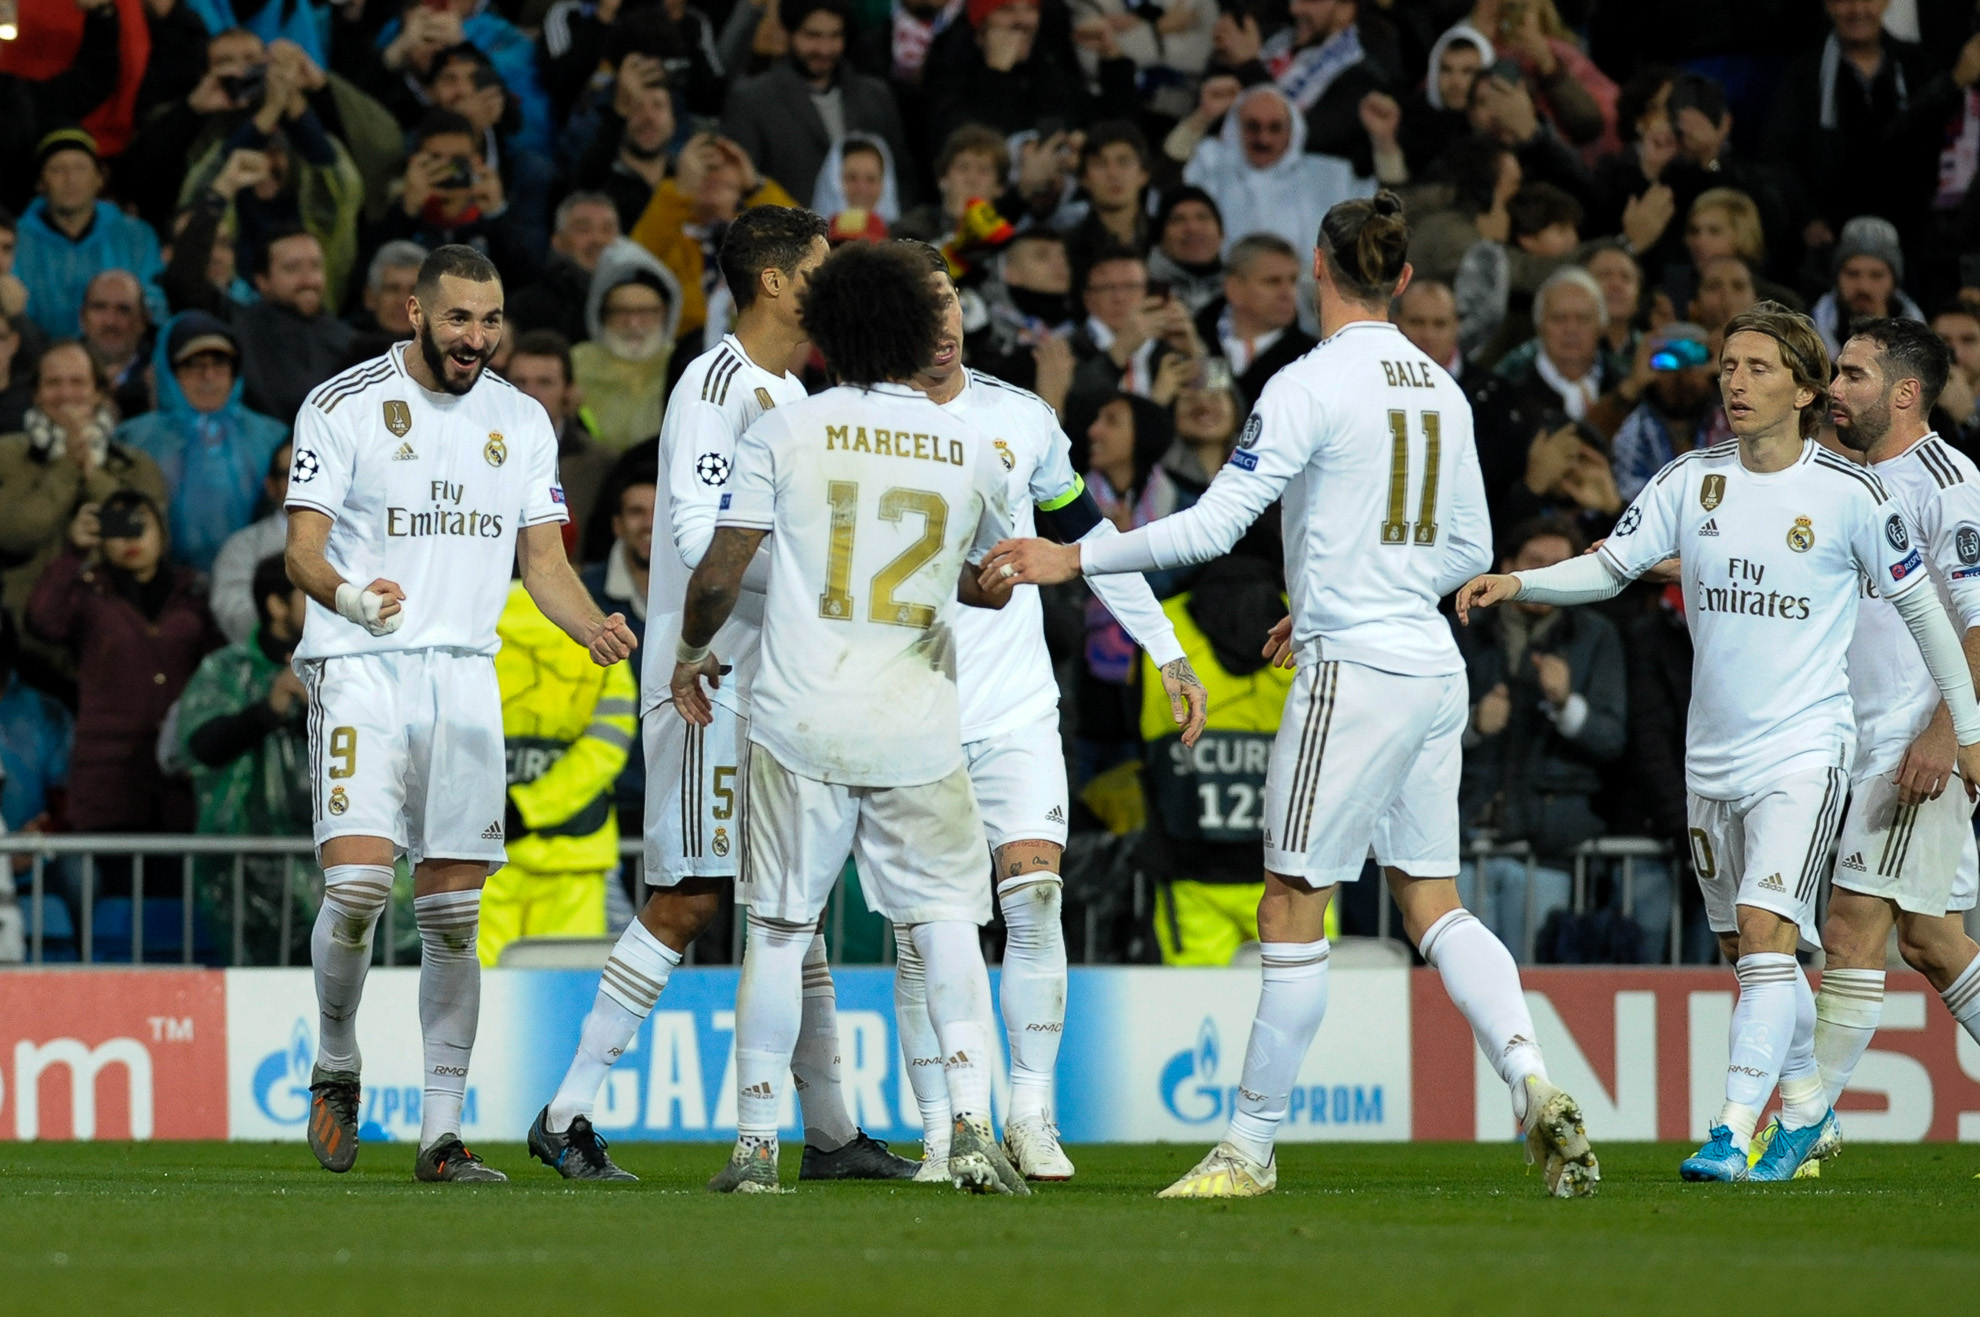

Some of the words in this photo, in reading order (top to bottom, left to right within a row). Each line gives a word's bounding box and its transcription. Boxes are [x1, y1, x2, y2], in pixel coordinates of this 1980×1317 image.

[1380, 360, 1436, 389] BALE
[825, 425, 964, 467] MARCELO
[430, 480, 464, 505] Fly
[1380, 408, 1440, 547] 11
[387, 504, 503, 538] Emirates
[819, 480, 950, 629] 12
[1728, 558, 1765, 586] Fly
[328, 726, 357, 780] 9
[712, 766, 738, 820] 5
[1198, 783, 1265, 829] 12
[1842, 860, 1877, 872] adidas
[1757, 881, 1787, 894] adidas
[0, 1036, 153, 1141] m
[1727, 1064, 1769, 1078] RMCF
